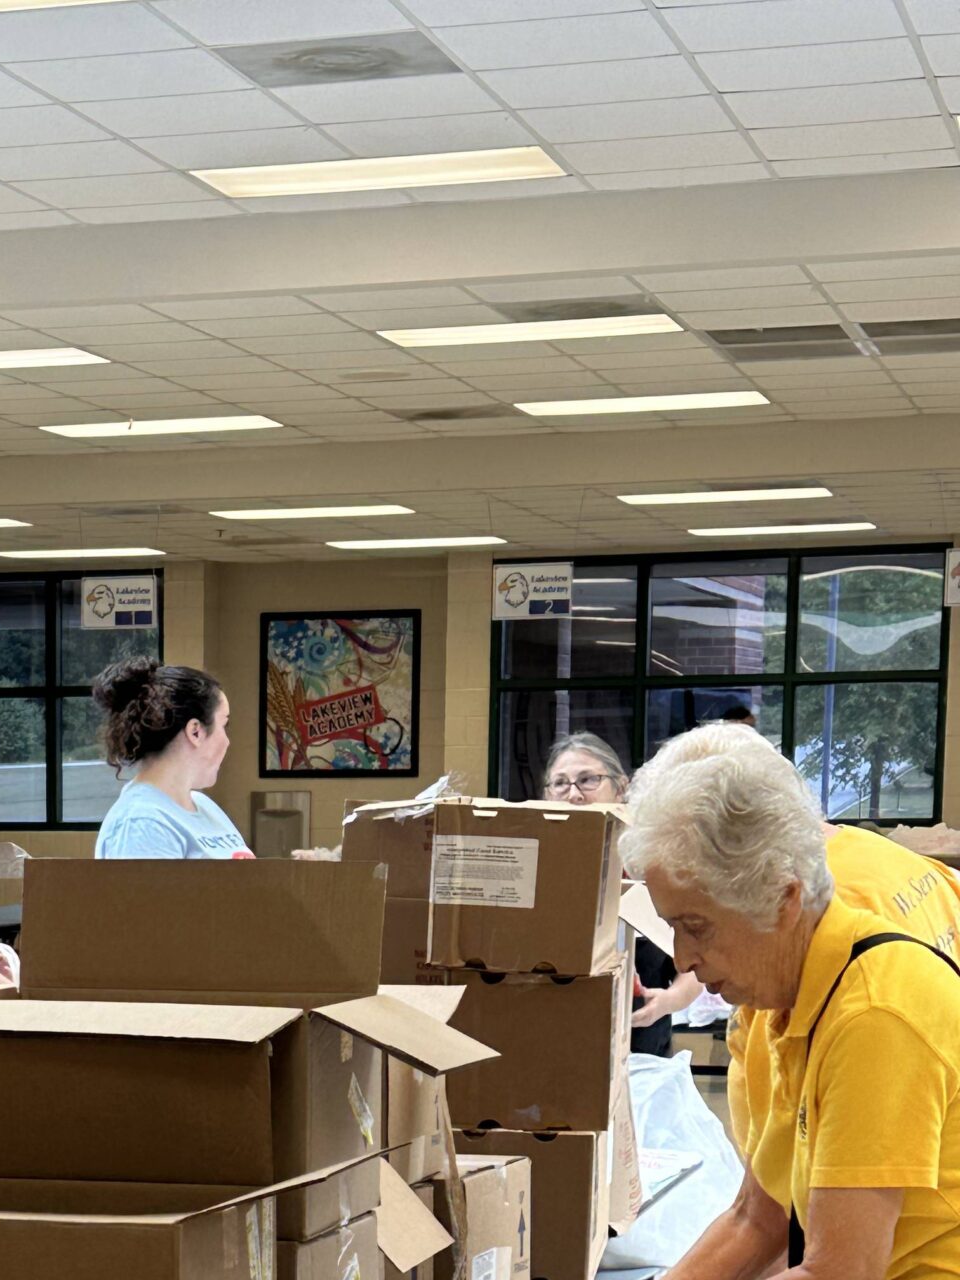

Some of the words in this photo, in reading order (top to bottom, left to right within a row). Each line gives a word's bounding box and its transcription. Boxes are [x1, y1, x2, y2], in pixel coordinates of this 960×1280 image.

[544, 600, 554, 613] 2
[301, 691, 373, 723] LAKEVIEW
[308, 706, 375, 738] ACADEMY
